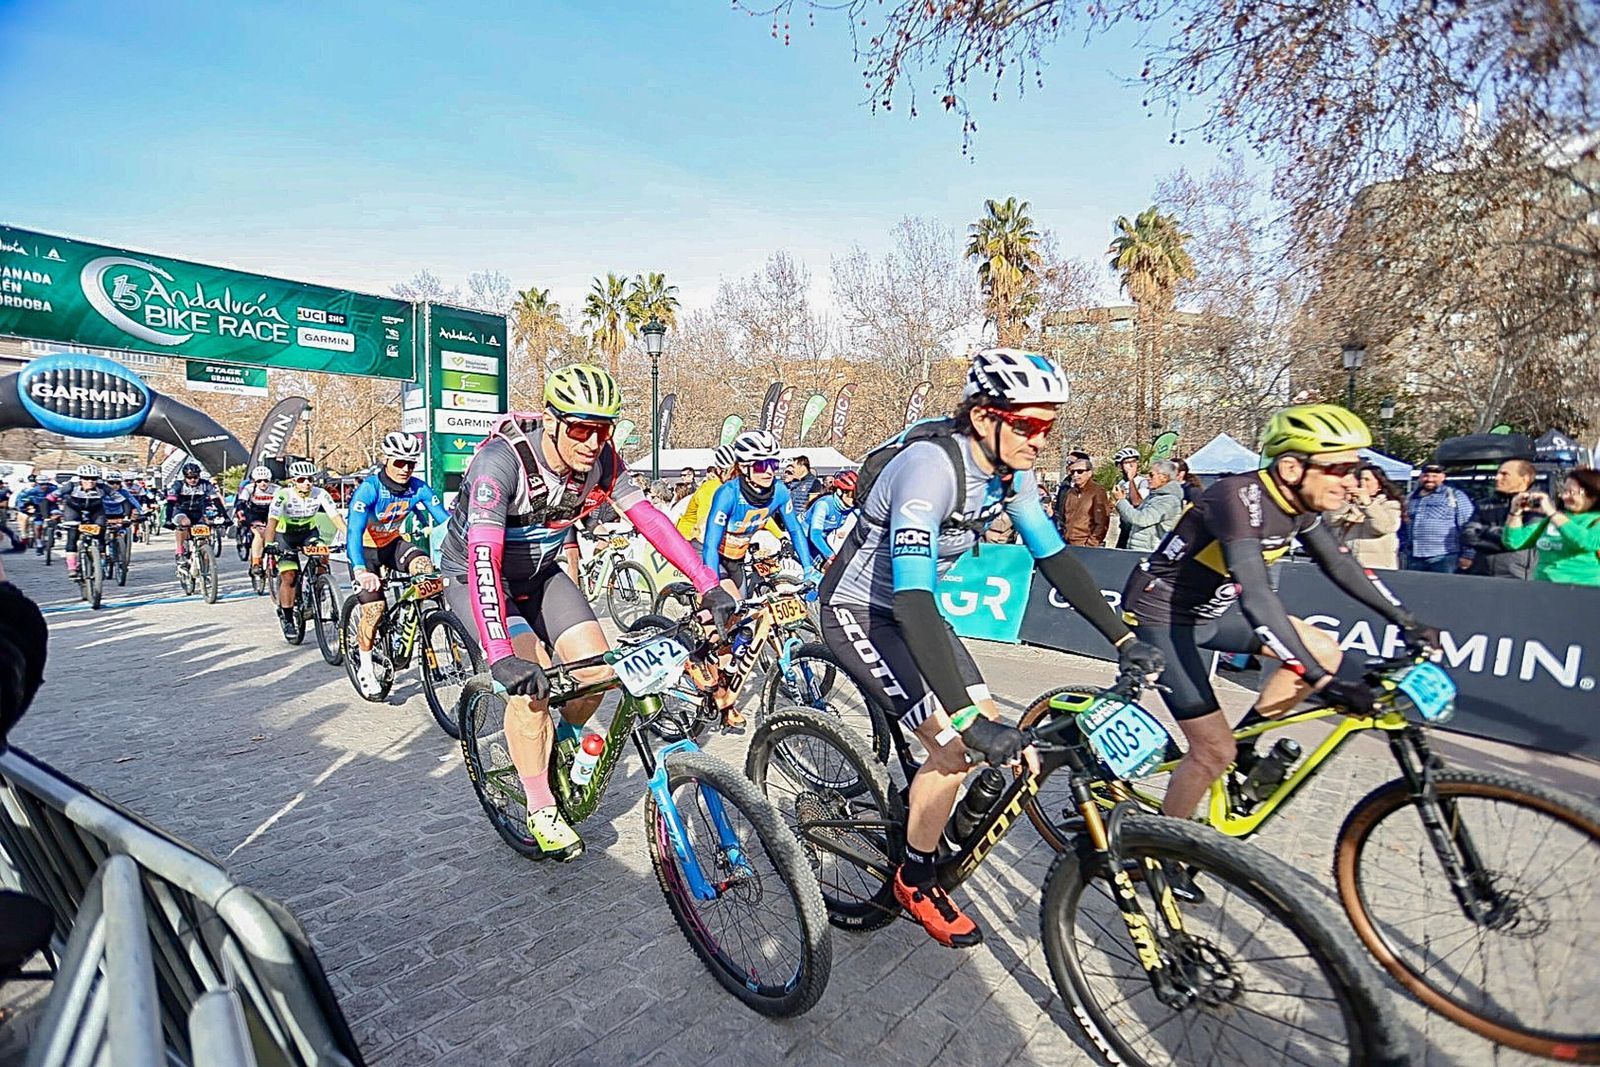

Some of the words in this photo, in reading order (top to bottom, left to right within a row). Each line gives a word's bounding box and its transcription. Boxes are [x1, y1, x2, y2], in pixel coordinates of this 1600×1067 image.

[0, 265, 52, 286] ANADA
[142, 273, 290, 324] Andalucía
[302, 310, 325, 322] UCI
[145, 304, 211, 333] BIKE
[218, 316, 290, 344] RACE
[304, 333, 349, 346] GARMIN
[205, 365, 242, 376] STAGE
[31, 382, 140, 406] GARMIN
[474, 545, 507, 641] PIRATE
[623, 640, 682, 683] 404-2
[729, 638, 764, 693] BMC
[834, 607, 909, 701] SCOTT
[1098, 710, 1157, 764] 403-1
[957, 773, 1040, 880] SCOTT
